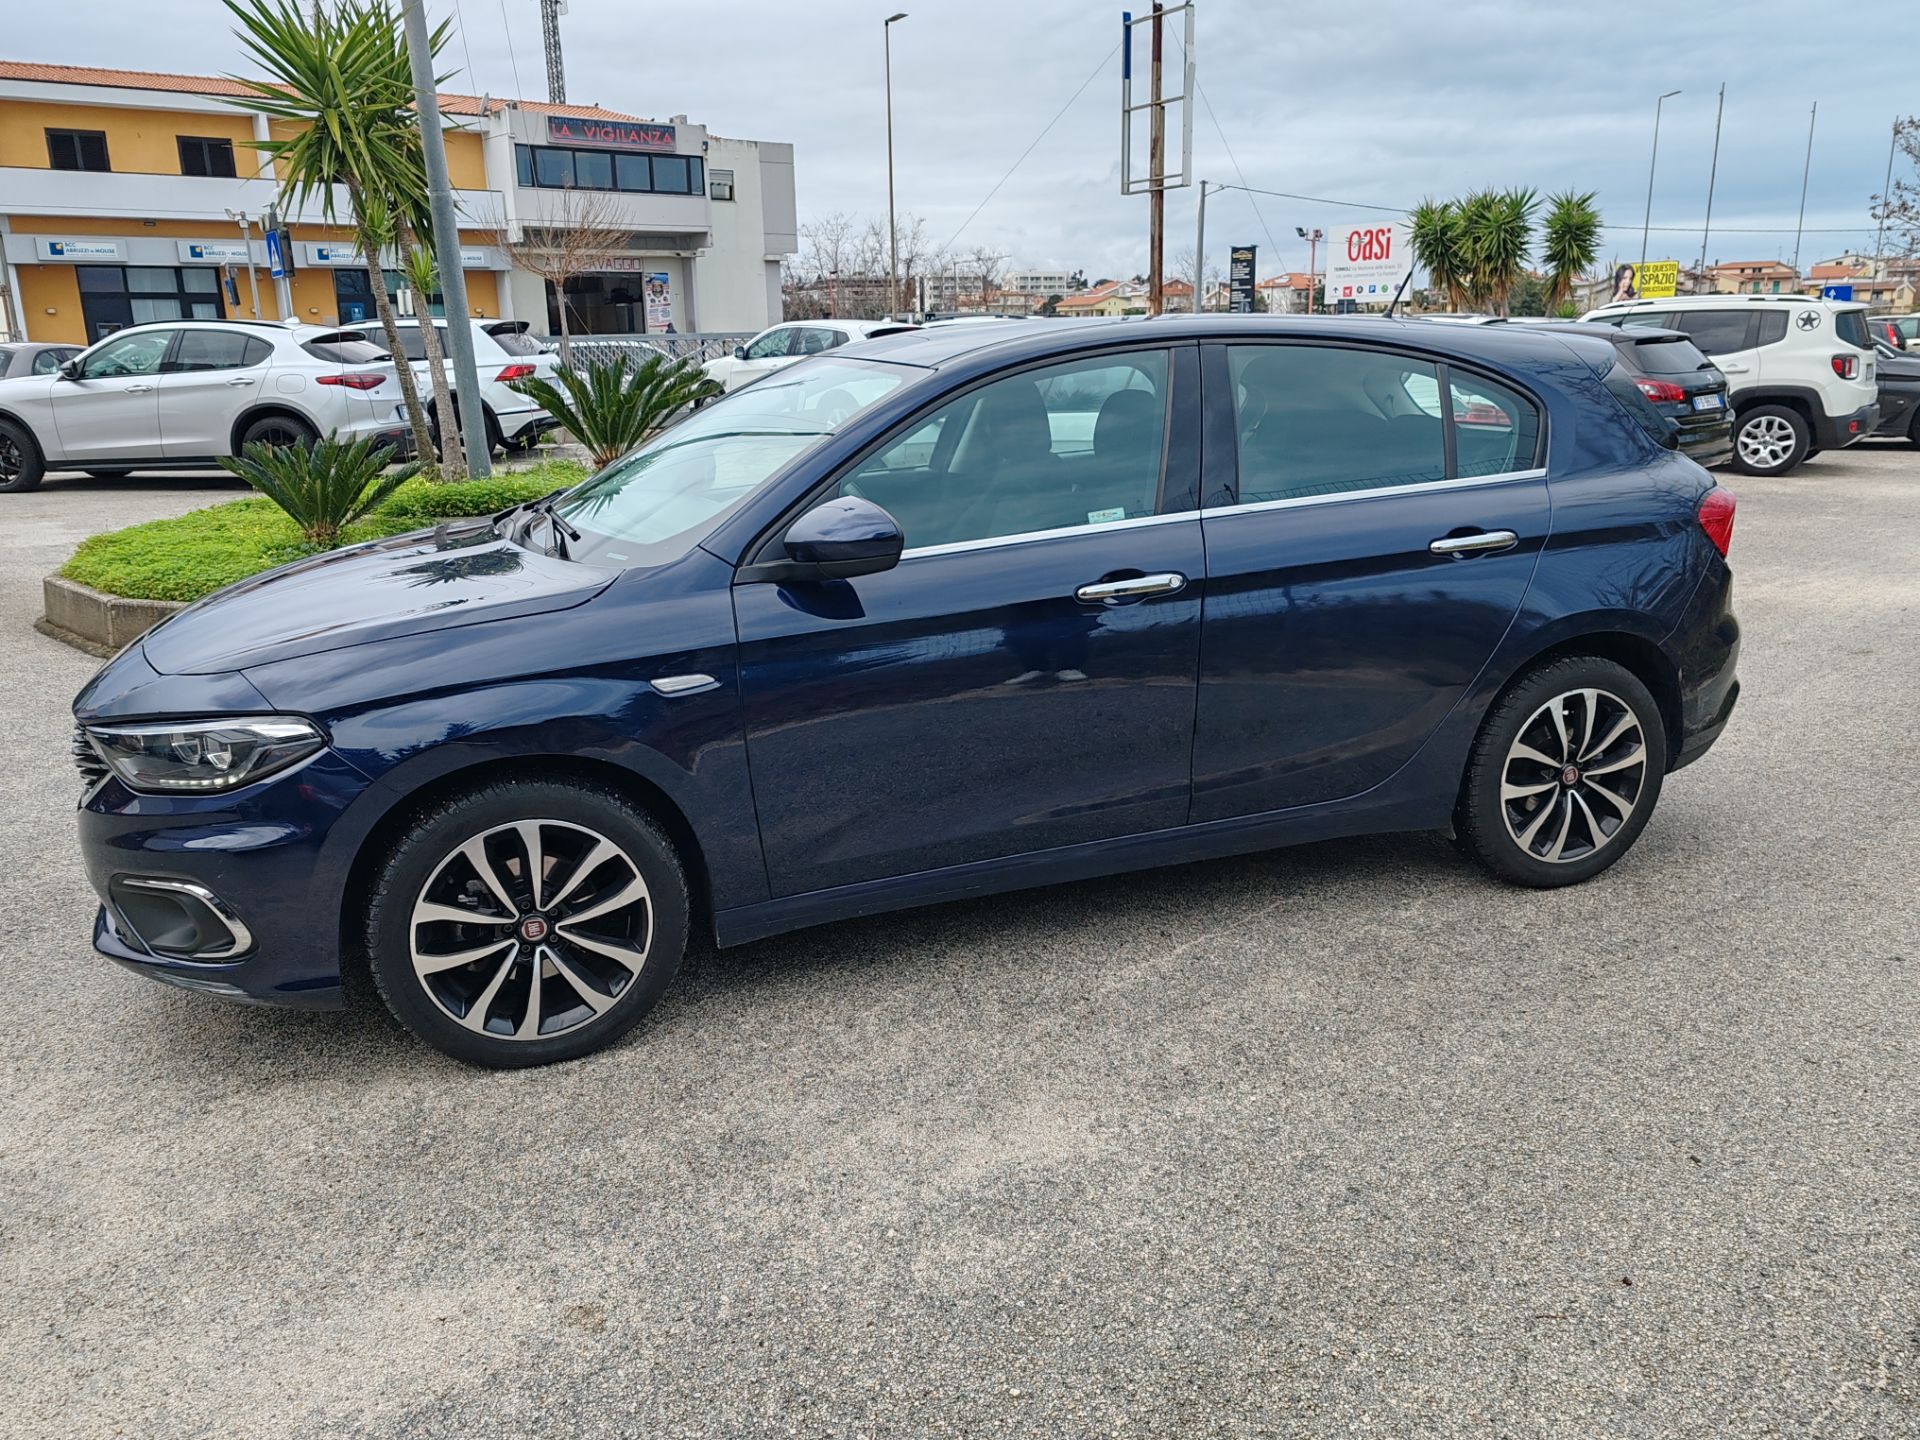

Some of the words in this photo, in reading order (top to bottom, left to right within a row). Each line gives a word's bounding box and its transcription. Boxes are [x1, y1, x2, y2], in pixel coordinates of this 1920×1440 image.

[551, 124, 573, 137] LA
[584, 126, 673, 145] VIGILANZA
[1634, 264, 1651, 273] VOI
[1652, 263, 1677, 273] QUESTO
[1641, 272, 1675, 285] SPAZIO
